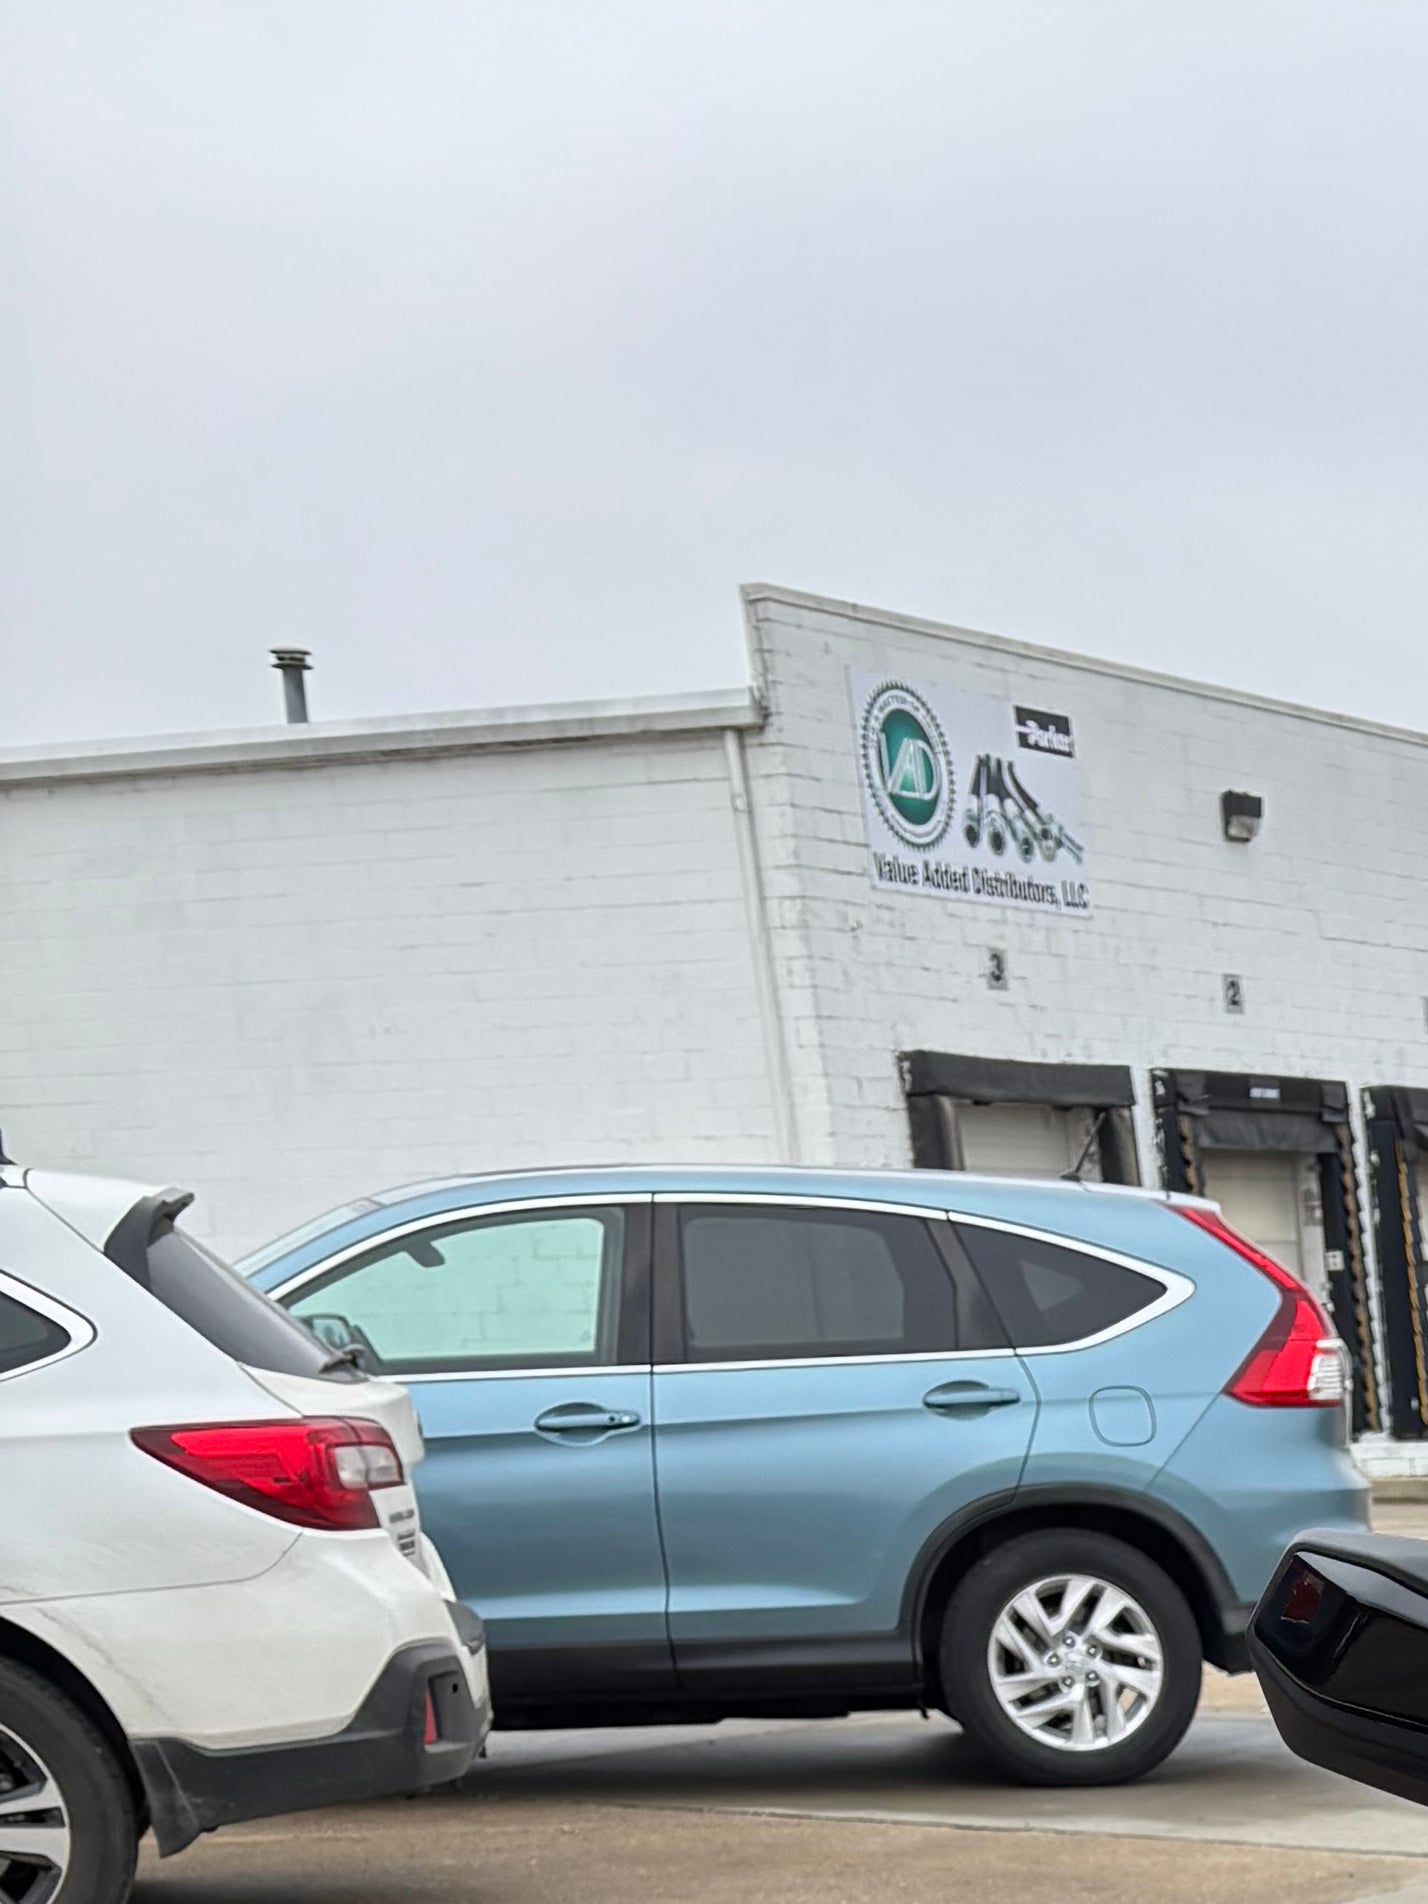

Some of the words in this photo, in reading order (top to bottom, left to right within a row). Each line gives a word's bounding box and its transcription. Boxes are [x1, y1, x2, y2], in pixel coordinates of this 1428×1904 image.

[873, 852, 919, 885] Value
[921, 859, 969, 893] Added
[972, 867, 1062, 911] Distributors,
[1061, 879, 1090, 909] LLC
